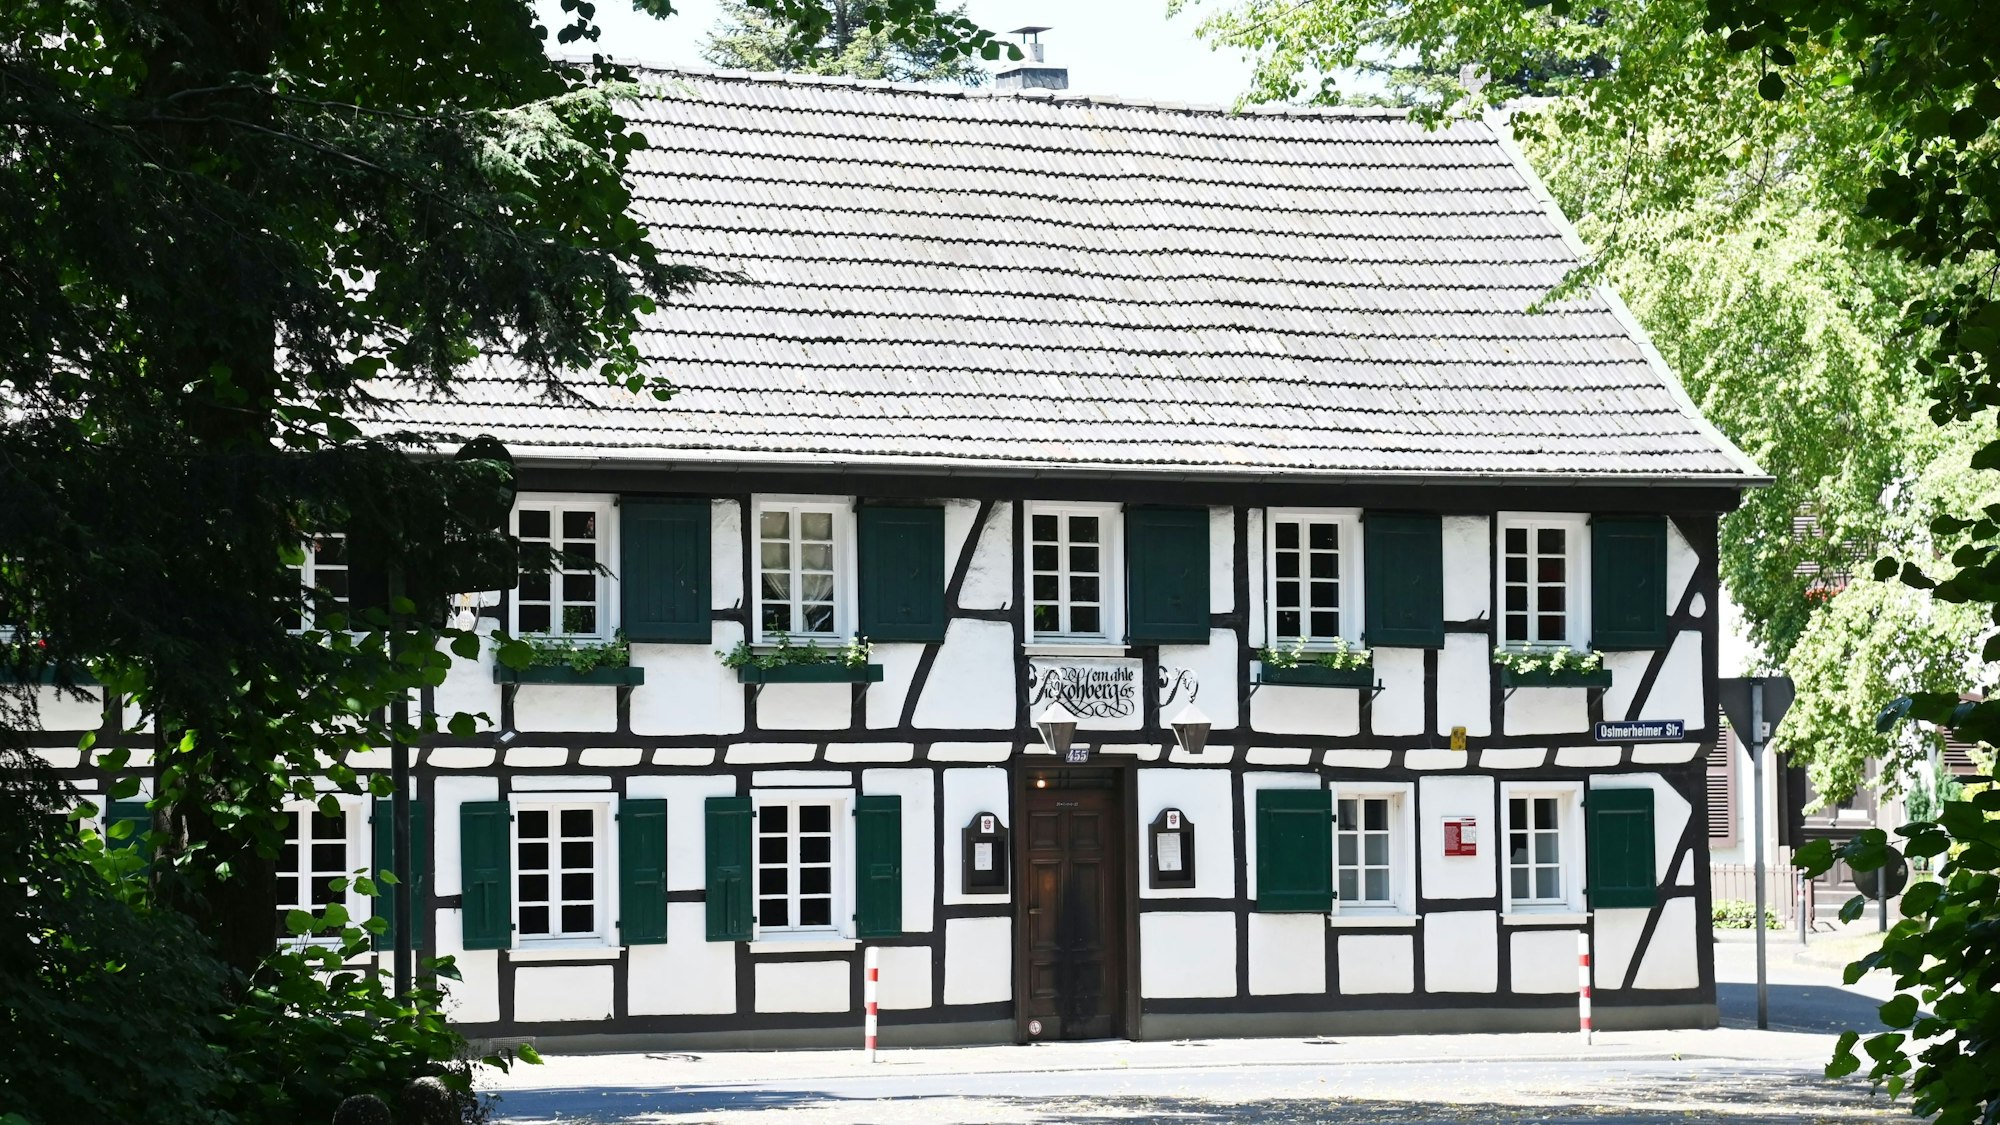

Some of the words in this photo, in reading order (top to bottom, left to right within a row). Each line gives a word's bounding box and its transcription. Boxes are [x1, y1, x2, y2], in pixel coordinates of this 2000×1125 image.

[1601, 724, 1662, 737] Ostmerheimer
[1666, 723, 1681, 735] Str.
[1068, 749, 1087, 761] 455
